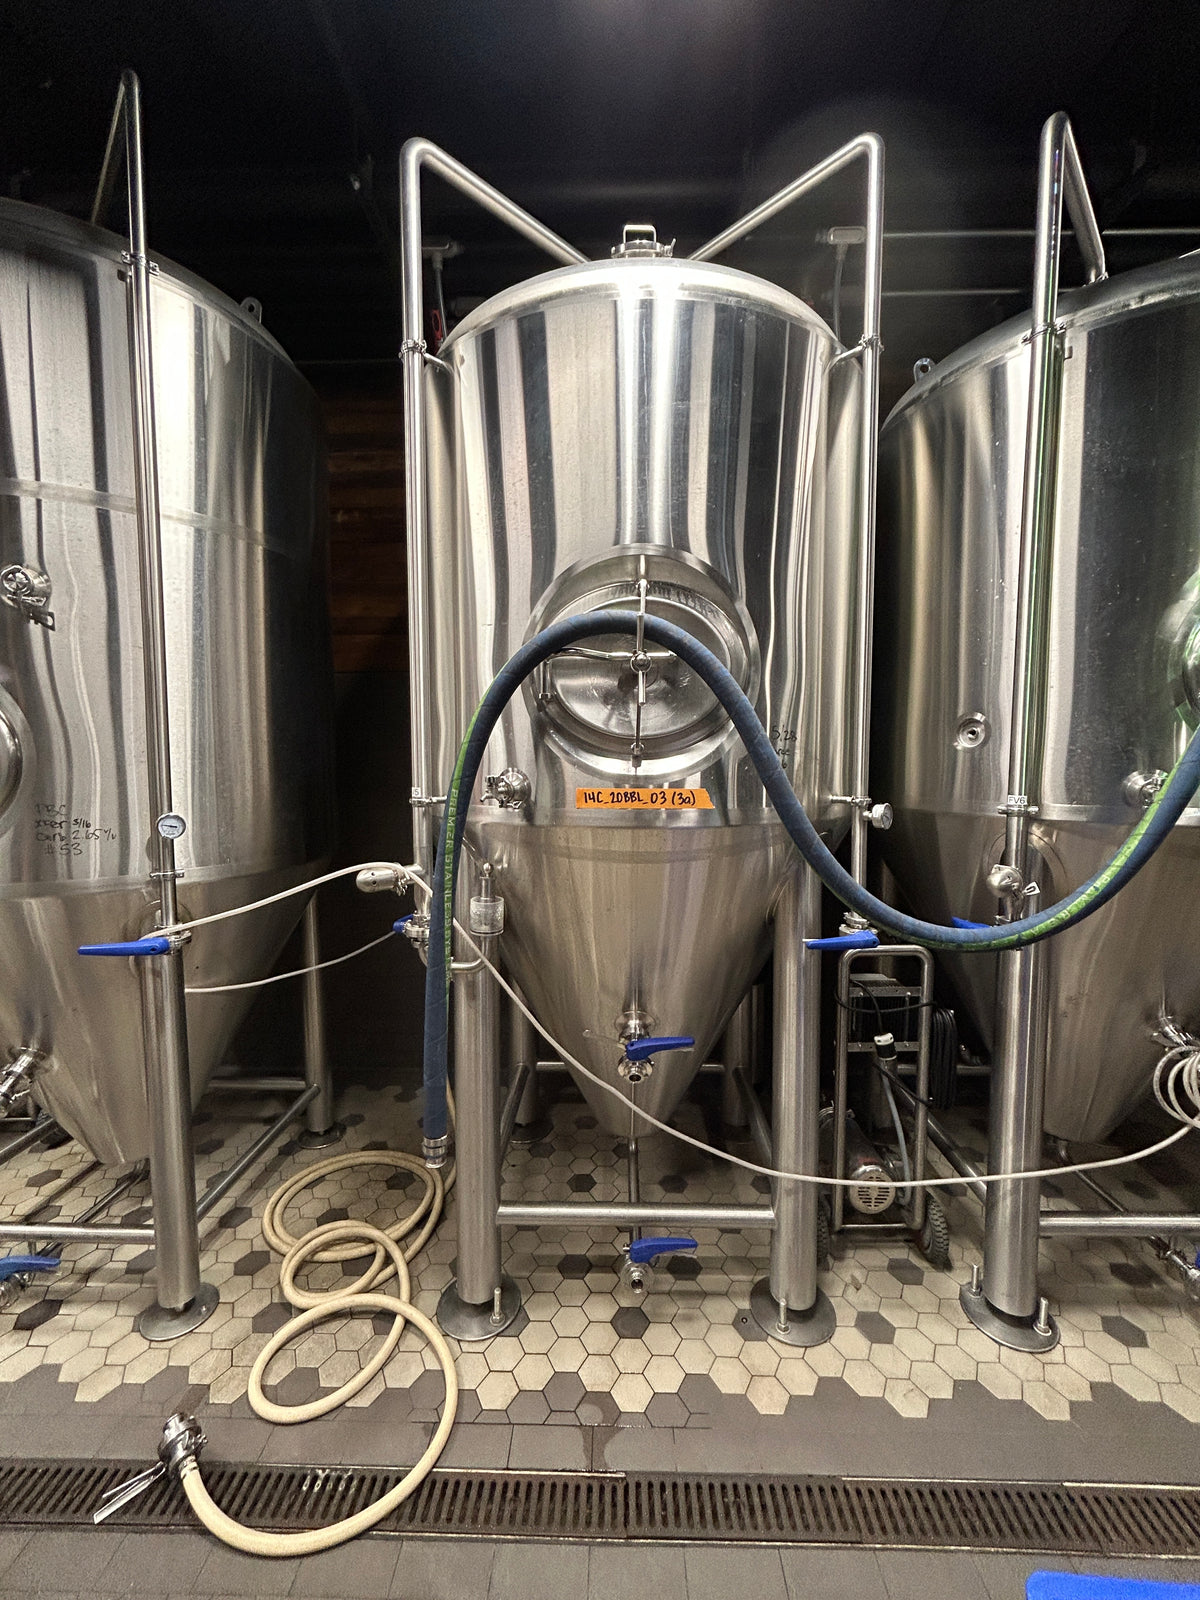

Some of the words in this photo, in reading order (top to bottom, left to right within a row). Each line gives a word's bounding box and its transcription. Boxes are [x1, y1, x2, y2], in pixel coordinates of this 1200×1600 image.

[671, 790, 696, 806] (3a)
[1008, 796, 1026, 805] FV6
[445, 788, 459, 848] PREMER
